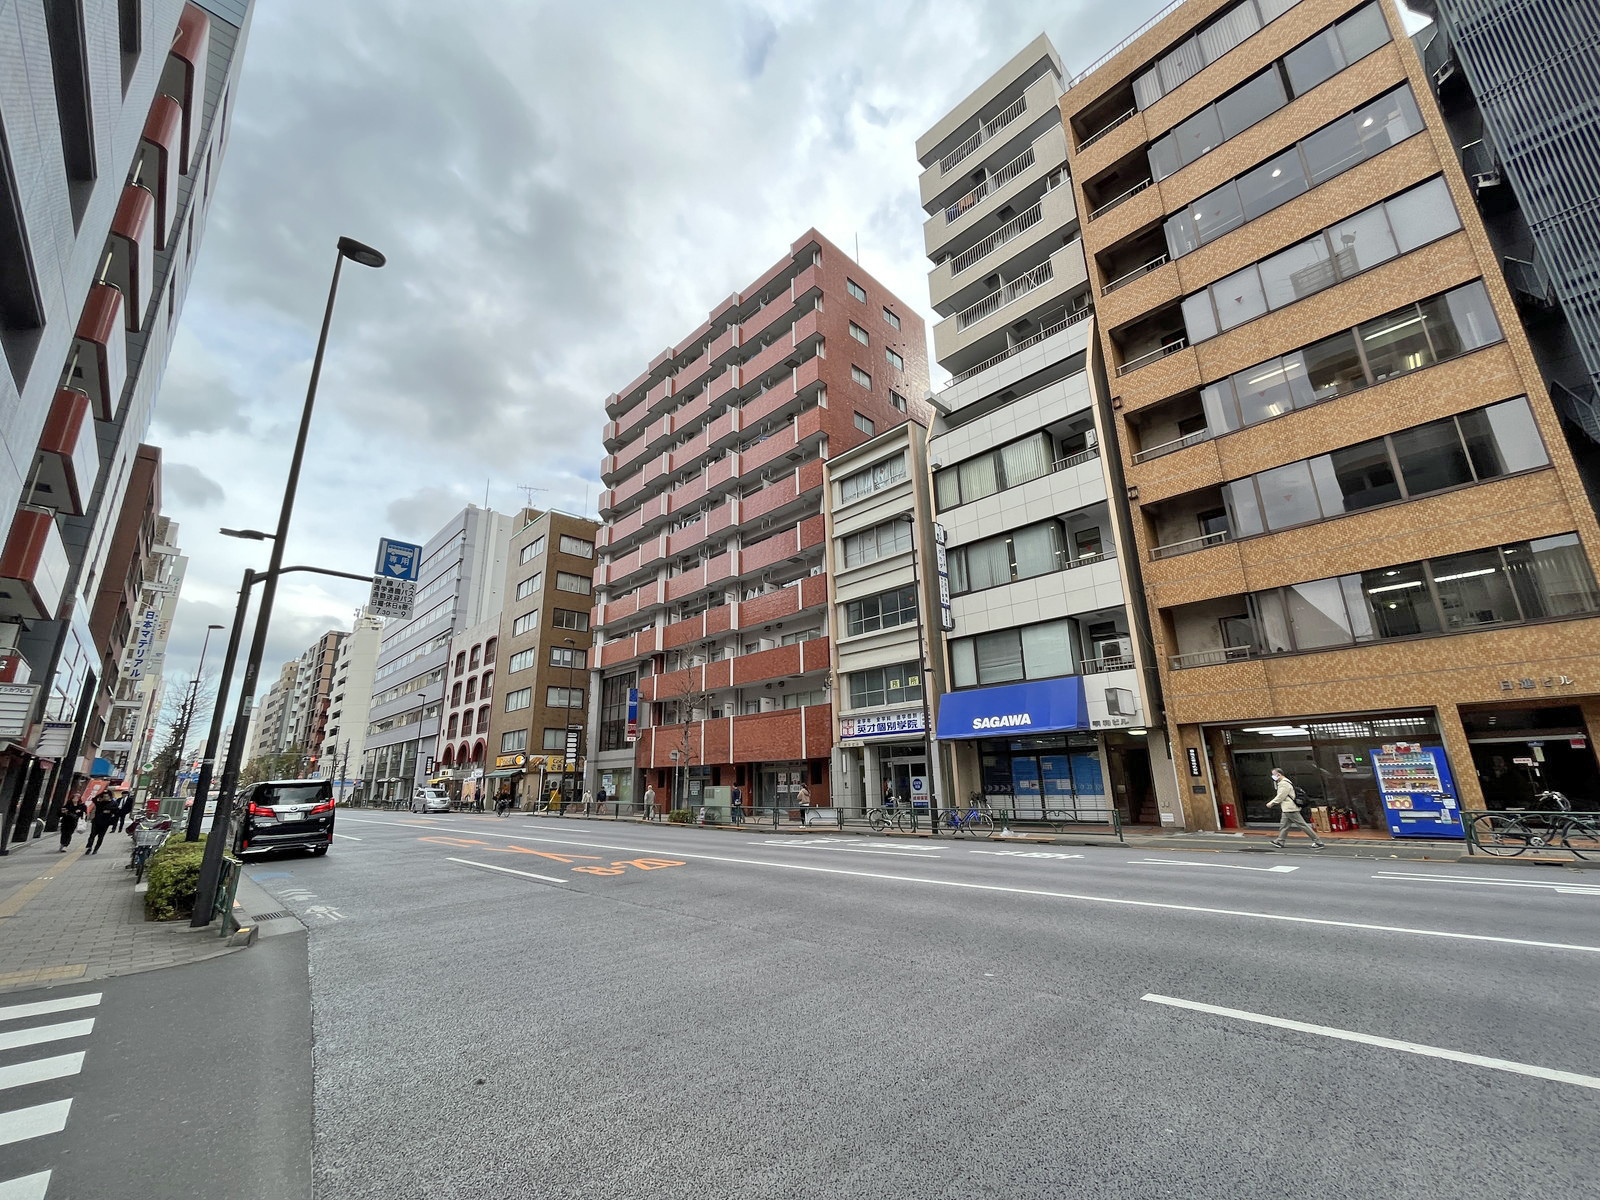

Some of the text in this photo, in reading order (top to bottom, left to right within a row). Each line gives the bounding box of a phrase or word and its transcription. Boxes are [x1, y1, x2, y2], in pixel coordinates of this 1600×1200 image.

[129, 610, 155, 678] 日本マテリアル
[857, 719, 918, 734] 英才個別学院
[972, 713, 1031, 730] SAGAWA
